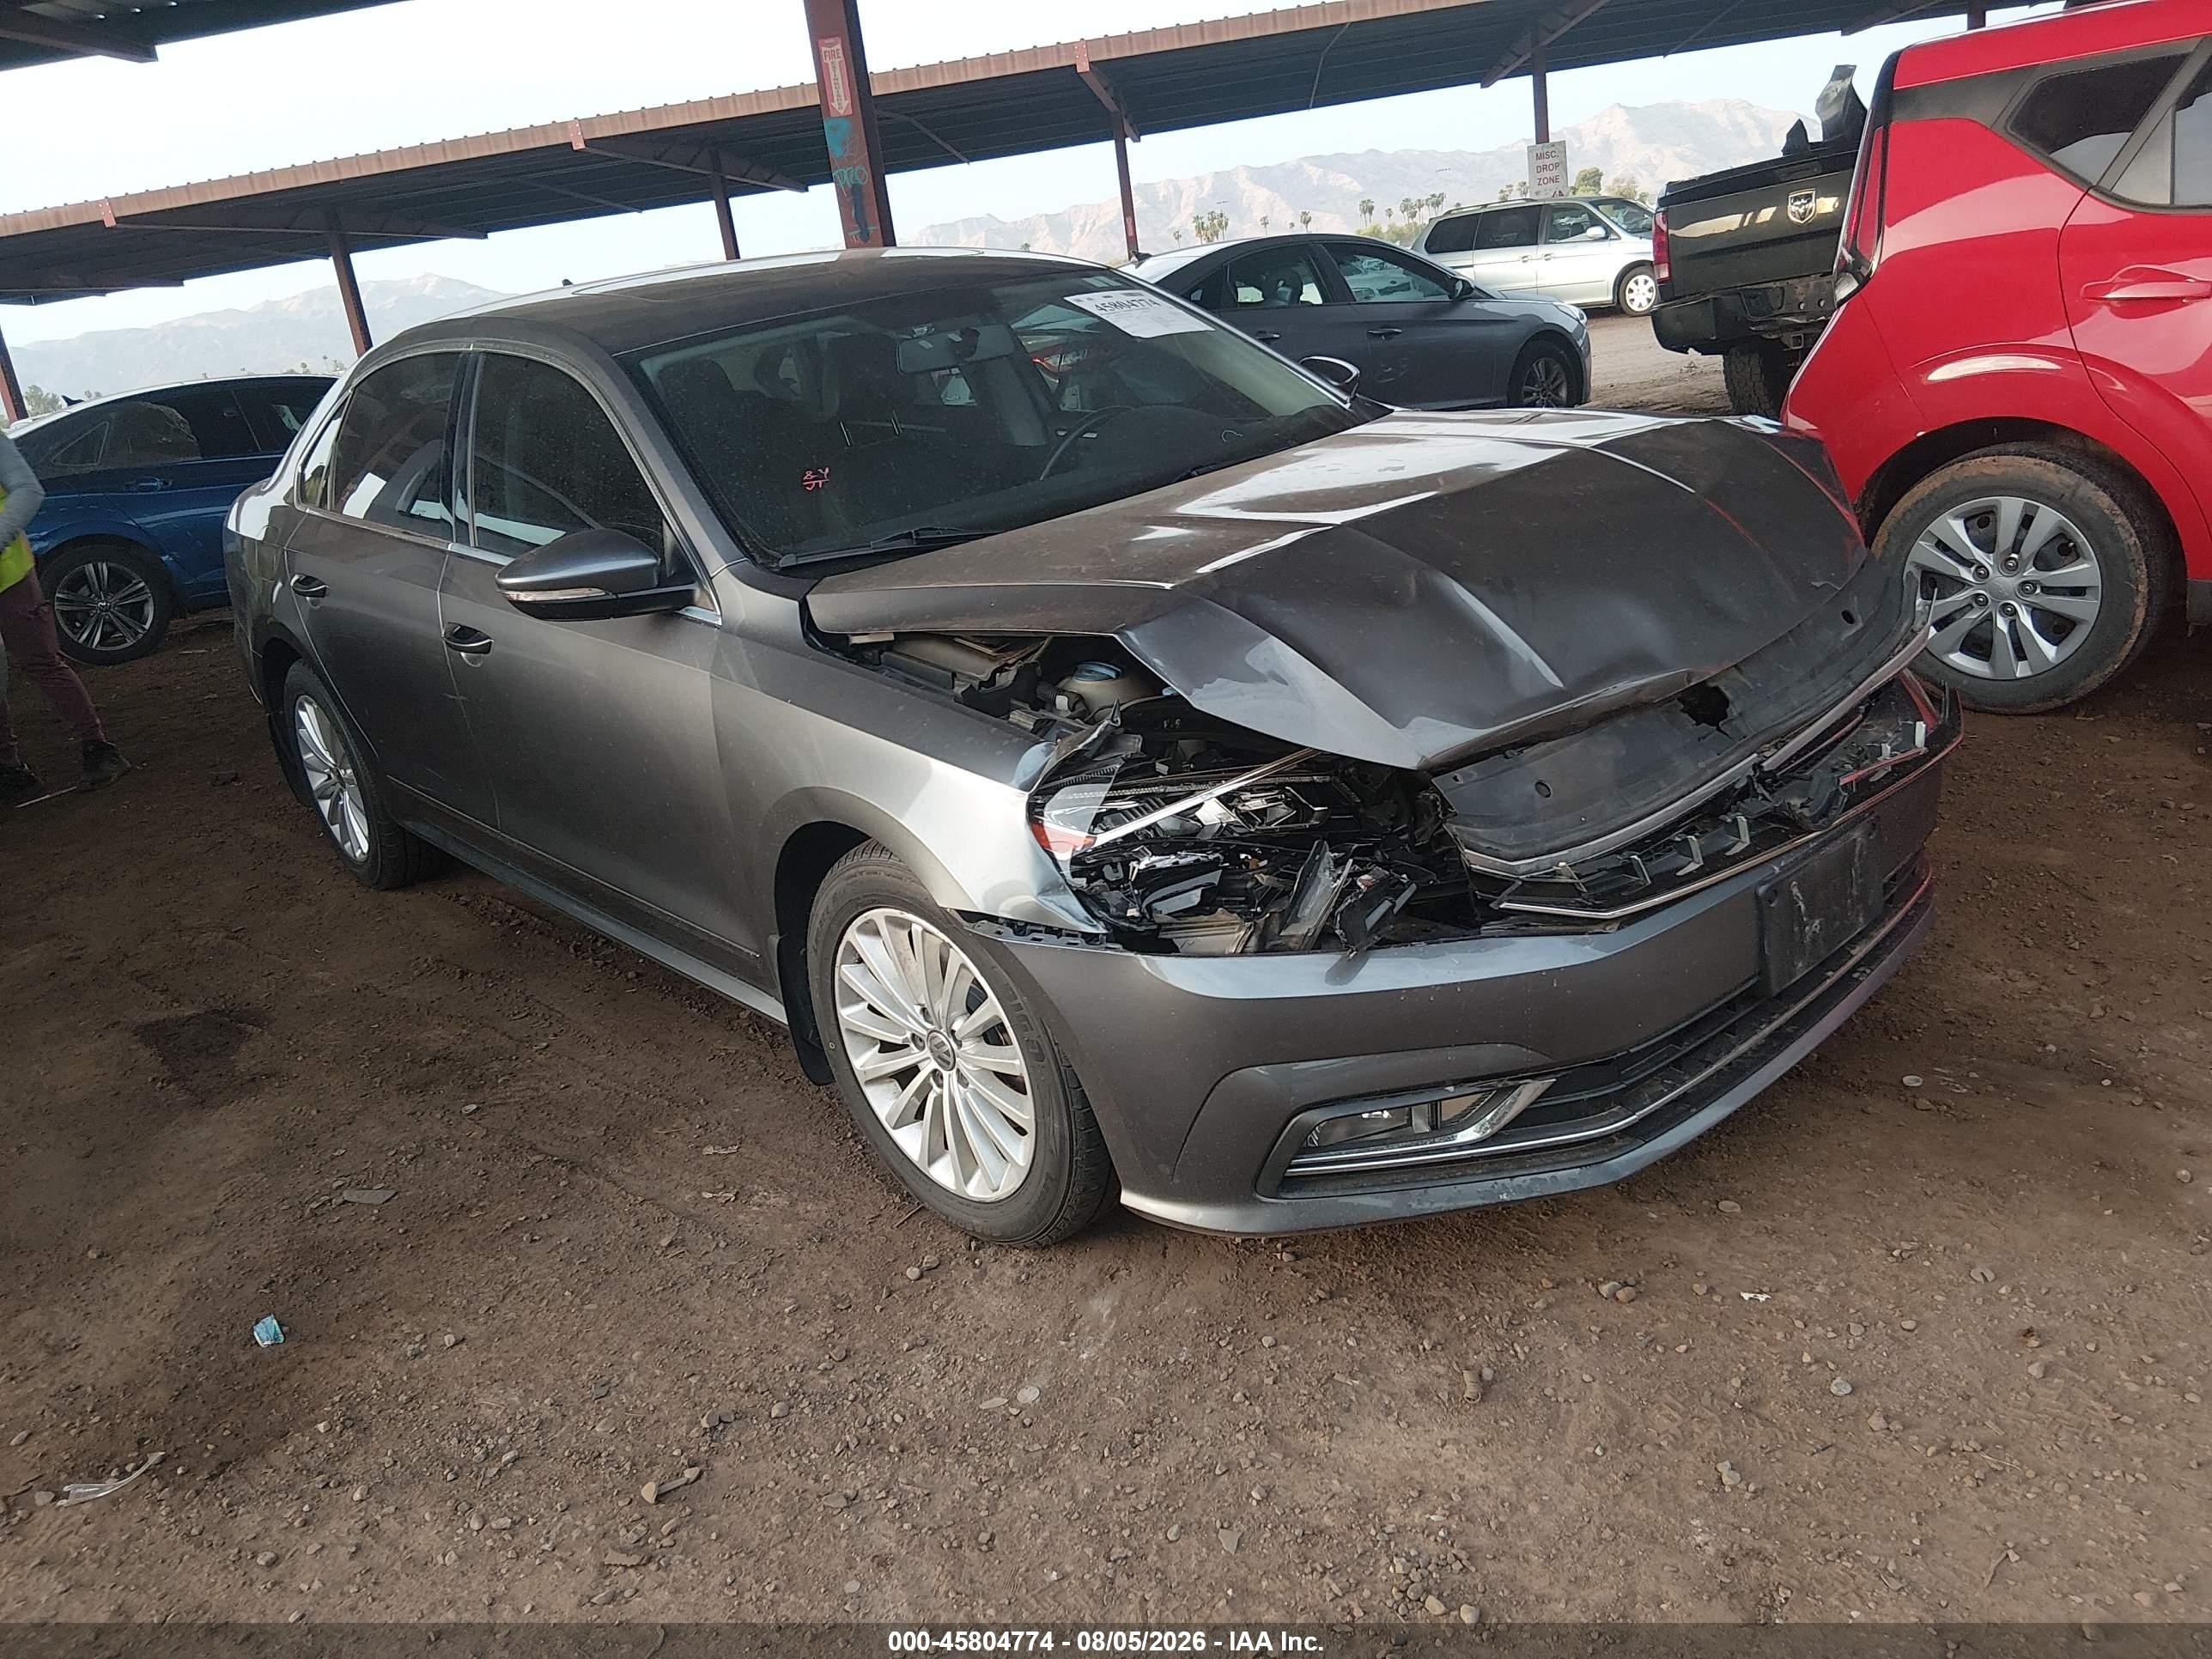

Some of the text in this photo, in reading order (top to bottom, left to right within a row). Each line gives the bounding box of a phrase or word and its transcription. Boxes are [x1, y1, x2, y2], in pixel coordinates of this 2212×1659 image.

[823, 49, 842, 61] FIRE
[1535, 150, 1559, 160] MISC.
[1536, 162, 1559, 173] DROP
[1537, 175, 1559, 185] ZONE
[1094, 299, 1162, 312] 45804774
